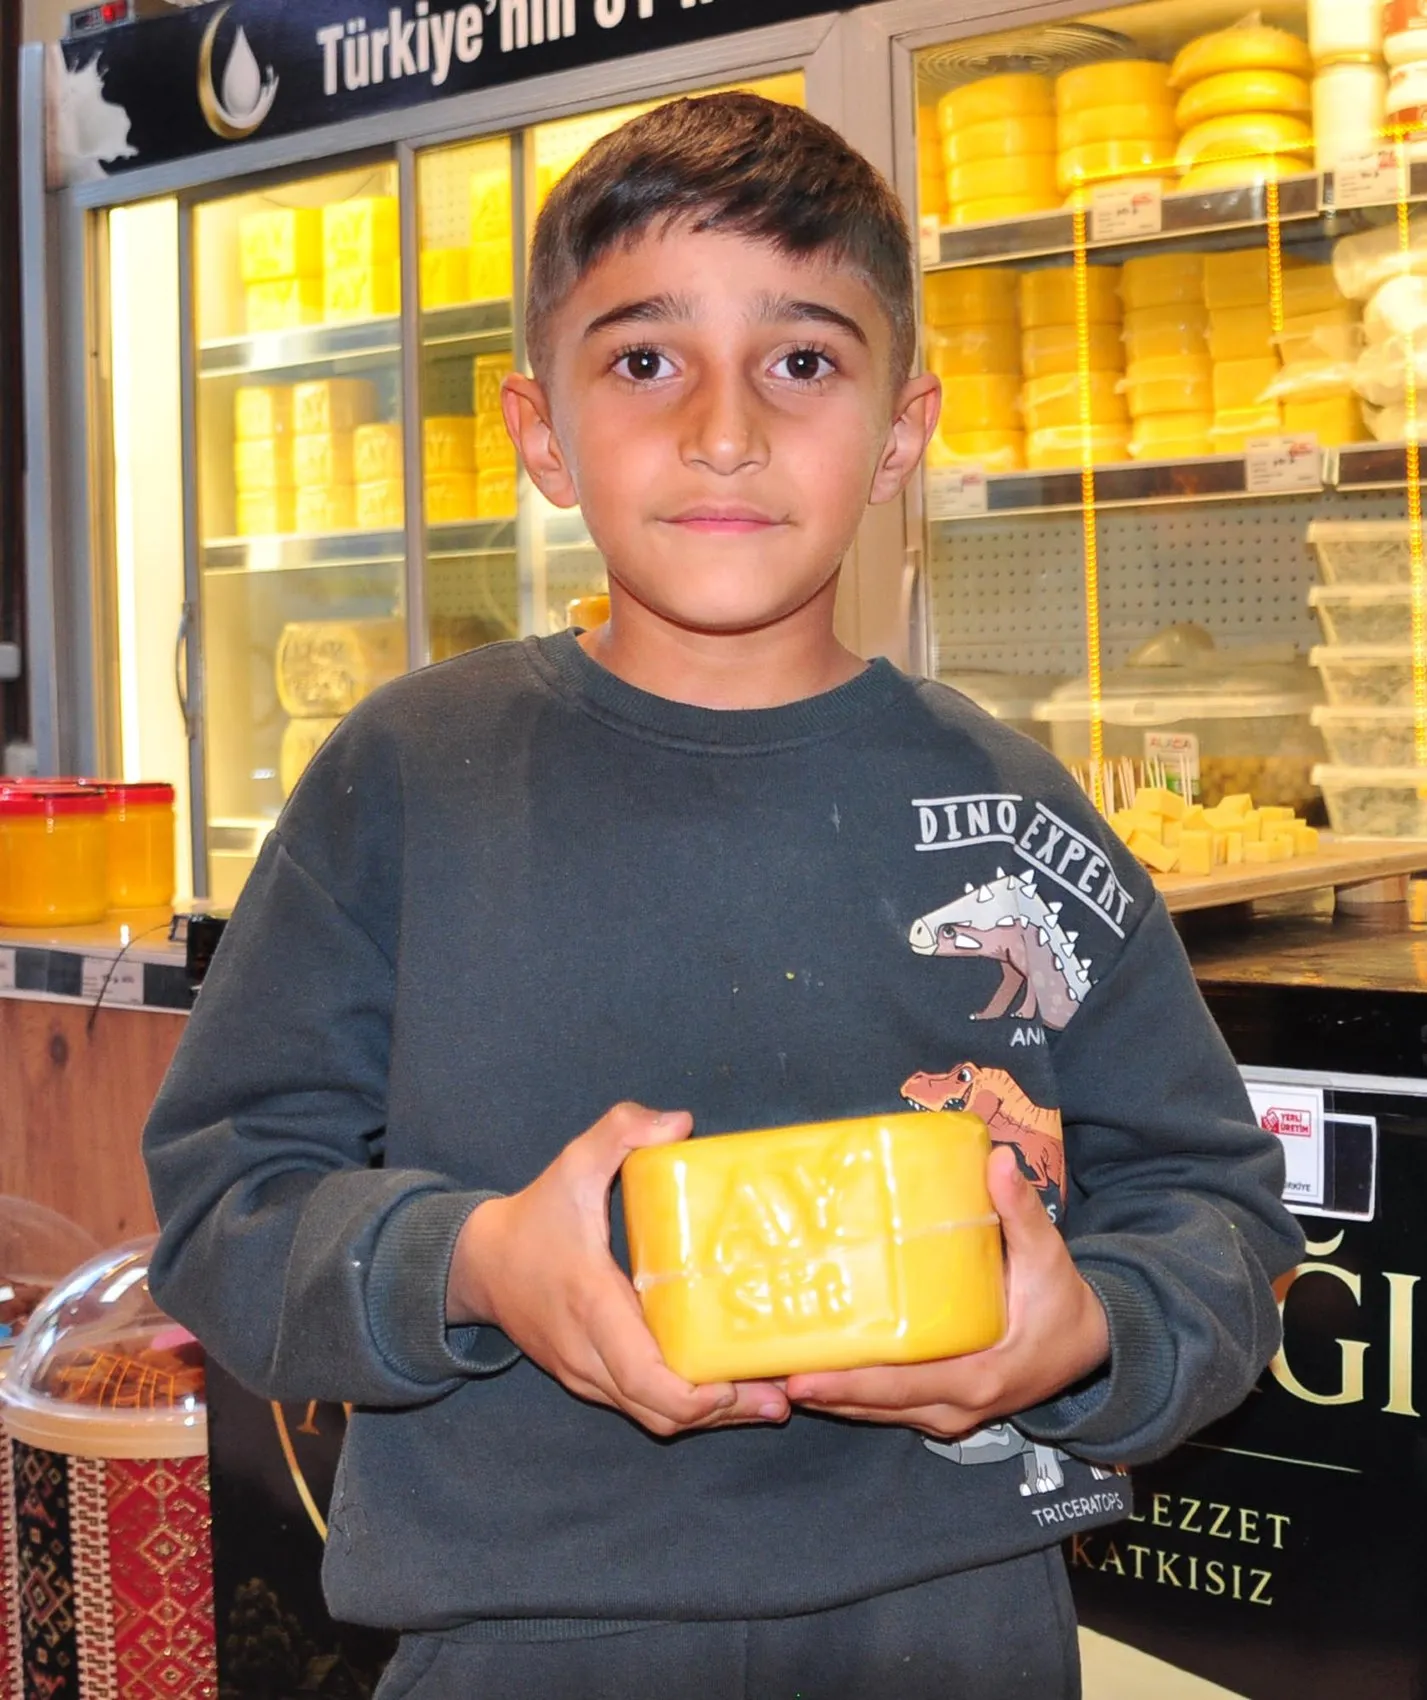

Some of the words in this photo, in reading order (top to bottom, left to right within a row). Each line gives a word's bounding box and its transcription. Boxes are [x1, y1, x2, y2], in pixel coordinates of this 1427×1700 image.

[918, 800, 1017, 844] DINO
[1019, 813, 1129, 924] EXPERT
[1280, 1112, 1303, 1123] YERLİ
[1280, 1123, 1309, 1133] ÜRETİM
[1031, 1491, 1124, 1527] TRICERATOPS
[1070, 1533, 1274, 1606] KATKISIZ
